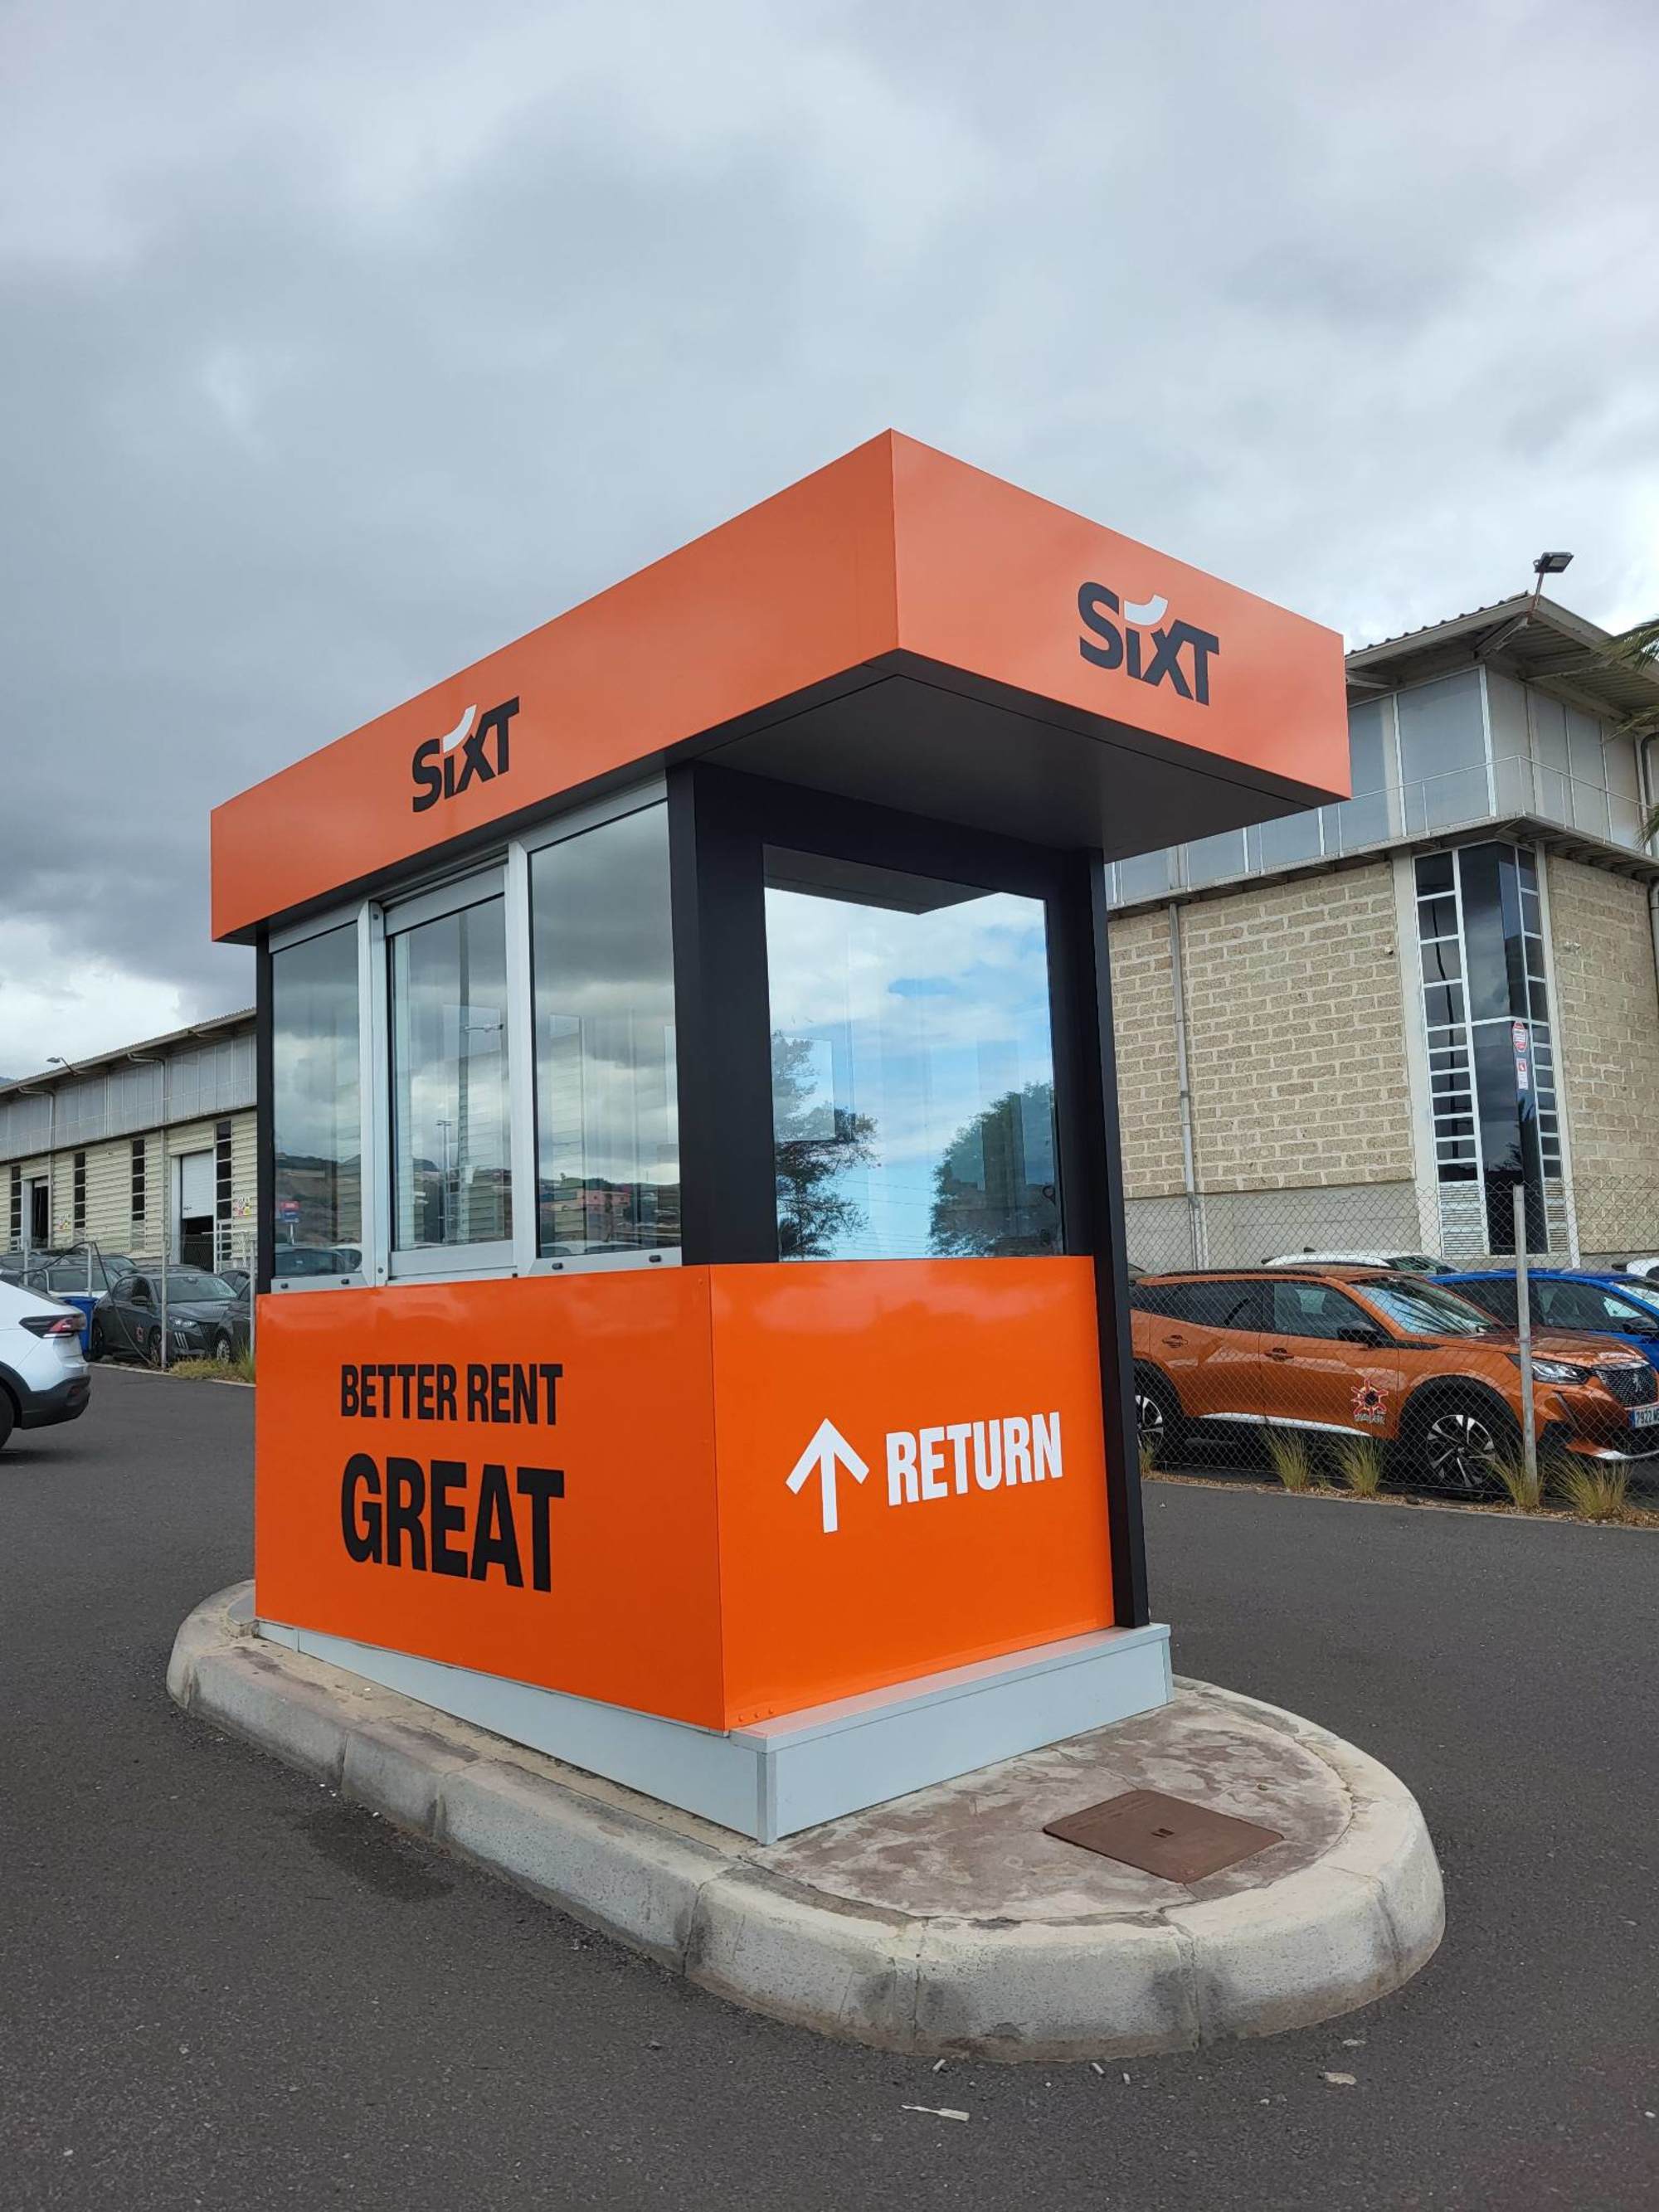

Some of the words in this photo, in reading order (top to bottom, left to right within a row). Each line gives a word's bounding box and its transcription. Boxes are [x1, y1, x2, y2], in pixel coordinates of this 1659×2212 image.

[341, 1364, 458, 1421] BETTER
[467, 1364, 563, 1425] RENT
[886, 1411, 1063, 1506] RETURN
[341, 1452, 564, 1592] GREAT
